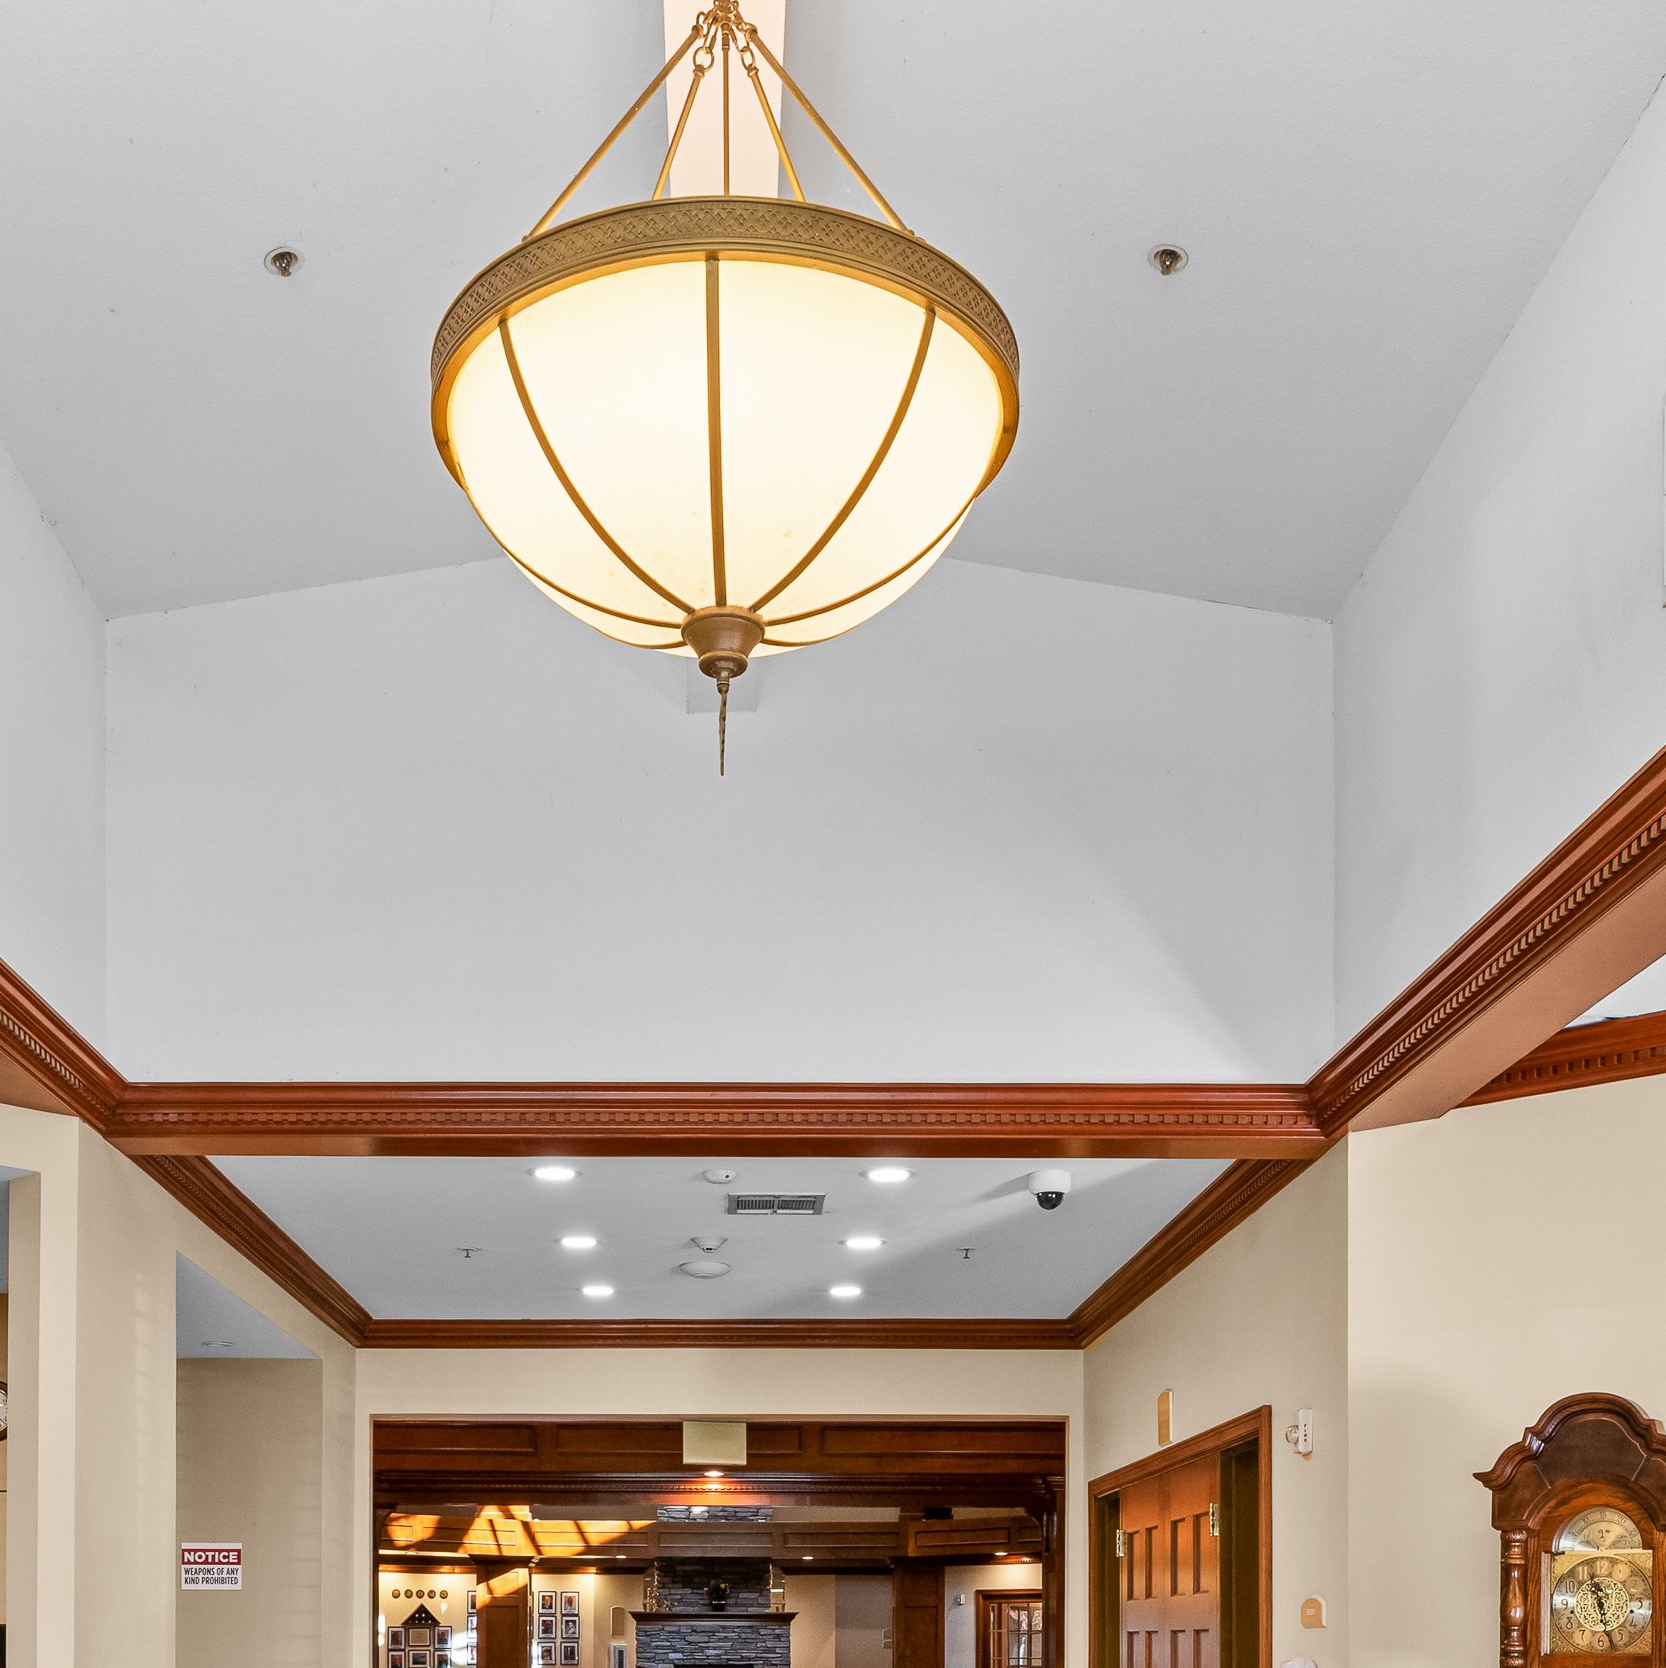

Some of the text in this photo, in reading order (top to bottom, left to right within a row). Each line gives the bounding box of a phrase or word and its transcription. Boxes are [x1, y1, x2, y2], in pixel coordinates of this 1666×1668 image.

[184, 1551, 238, 1563] NOTICE
[184, 1567, 239, 1576] WEAPONS OF ANY
[1579, 1566, 1588, 1580] 11
[1596, 1561, 1608, 1575] 12
[184, 1577, 239, 1585] KIND PROHIBITED
[1565, 1580, 1576, 1593] 10
[1561, 1598, 1569, 1611] 9
[1636, 1597, 1643, 1610] 3
[1566, 1616, 1574, 1630] 8
[1578, 1629, 1587, 1643] 7
[1597, 1634, 1604, 1647] 6
[1617, 1628, 1624, 1643] 5
